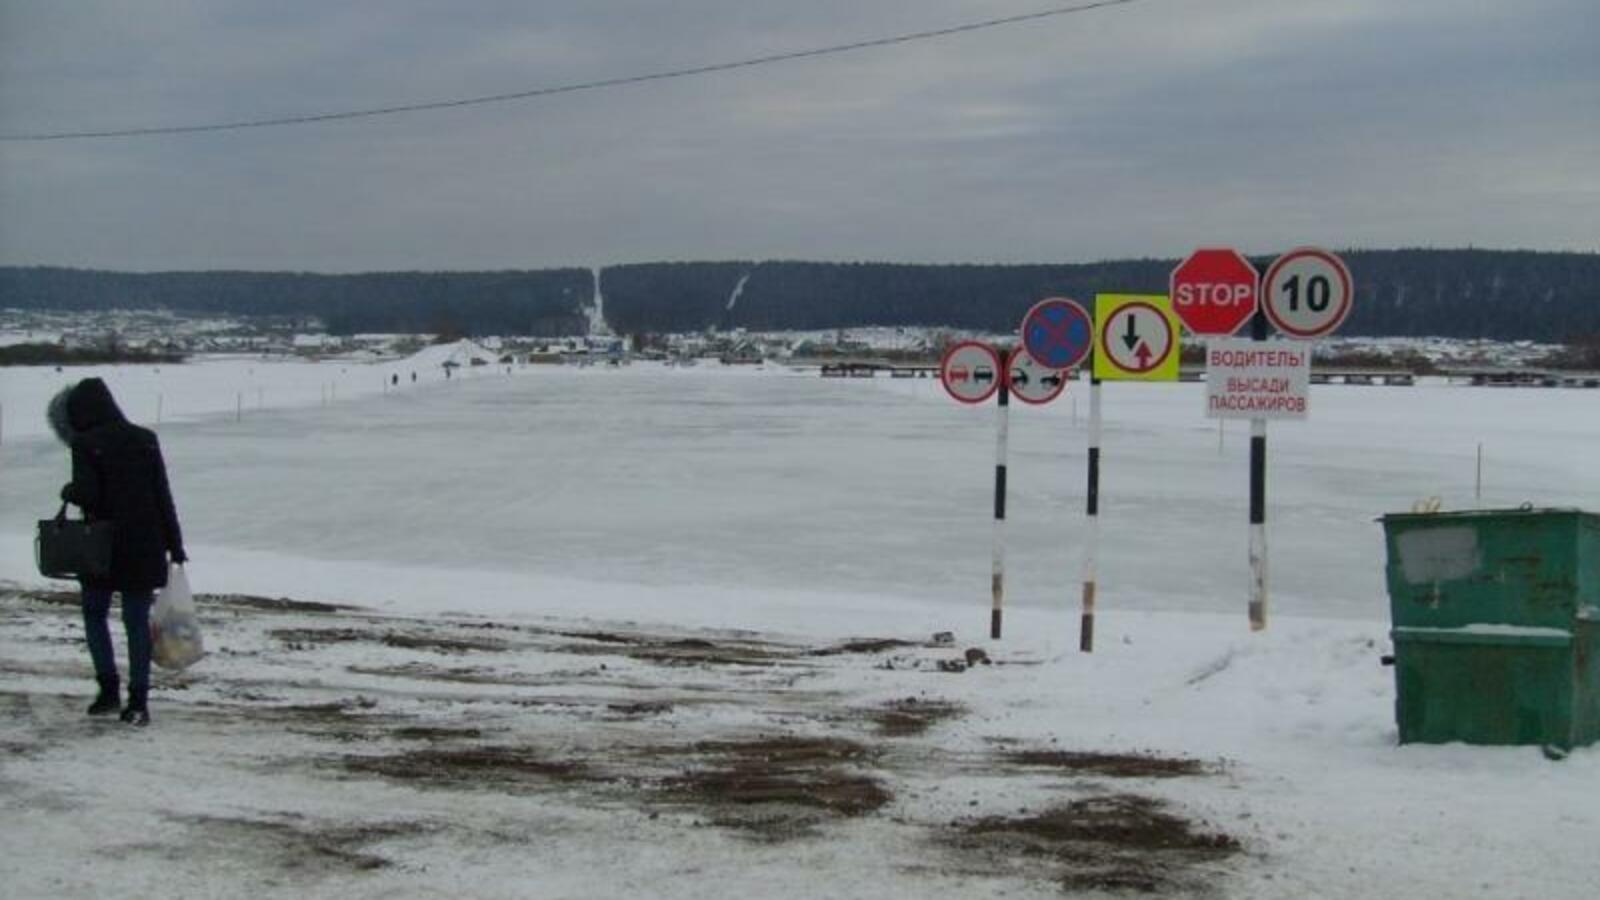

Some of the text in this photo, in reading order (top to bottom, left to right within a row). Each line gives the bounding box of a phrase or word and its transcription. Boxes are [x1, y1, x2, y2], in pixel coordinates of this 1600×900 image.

[1177, 283, 1250, 306] STOP
[1282, 275, 1330, 312] 10
[1211, 351, 1305, 369] ВОДИТЕЛЬ!
[1227, 377, 1289, 393] ВЫСАДИ
[1209, 396, 1306, 412] ПАССАЖИРОВ
